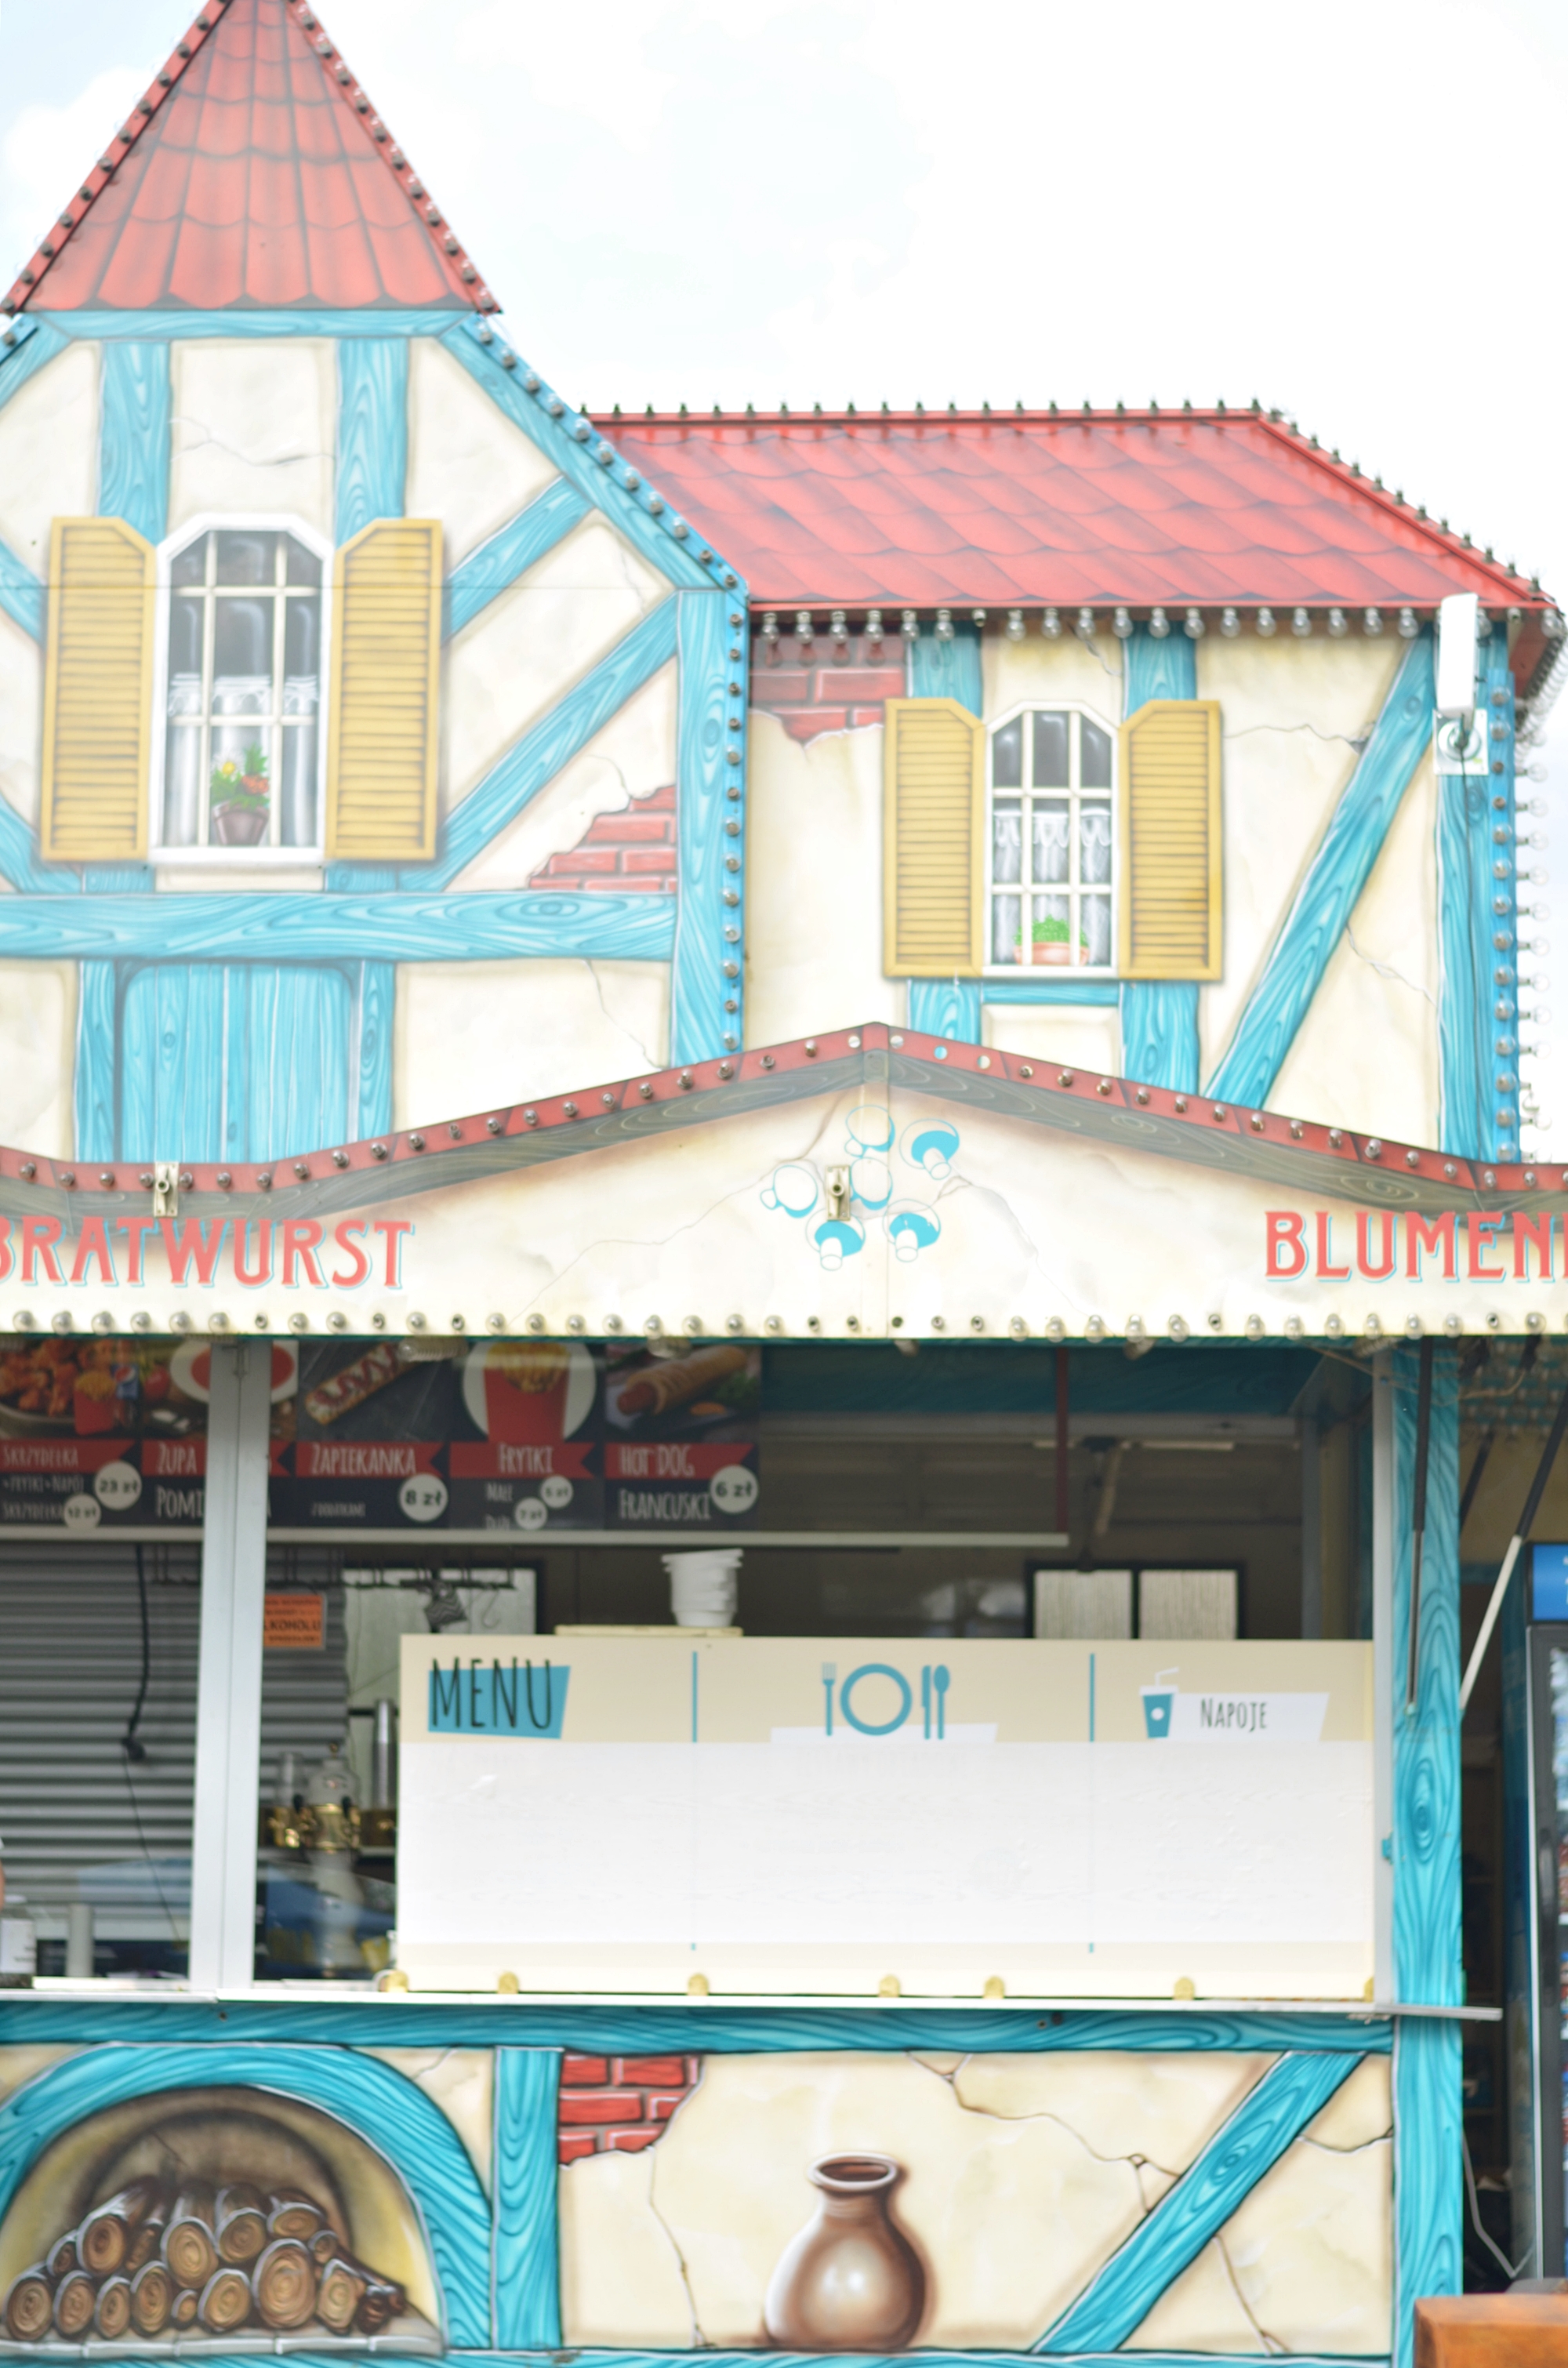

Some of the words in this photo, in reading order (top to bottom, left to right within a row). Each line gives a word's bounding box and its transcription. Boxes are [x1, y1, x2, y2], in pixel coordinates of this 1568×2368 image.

[1265, 1211, 1568, 1281] BLUMEN
[311, 1443, 417, 1476] ZAPIEKANKA
[621, 1444, 654, 1476] HOT
[658, 1444, 695, 1477] DOG
[619, 1488, 711, 1520] FRANCUSKI
[715, 1481, 728, 1498] 6
[433, 1656, 551, 1730] MENU
